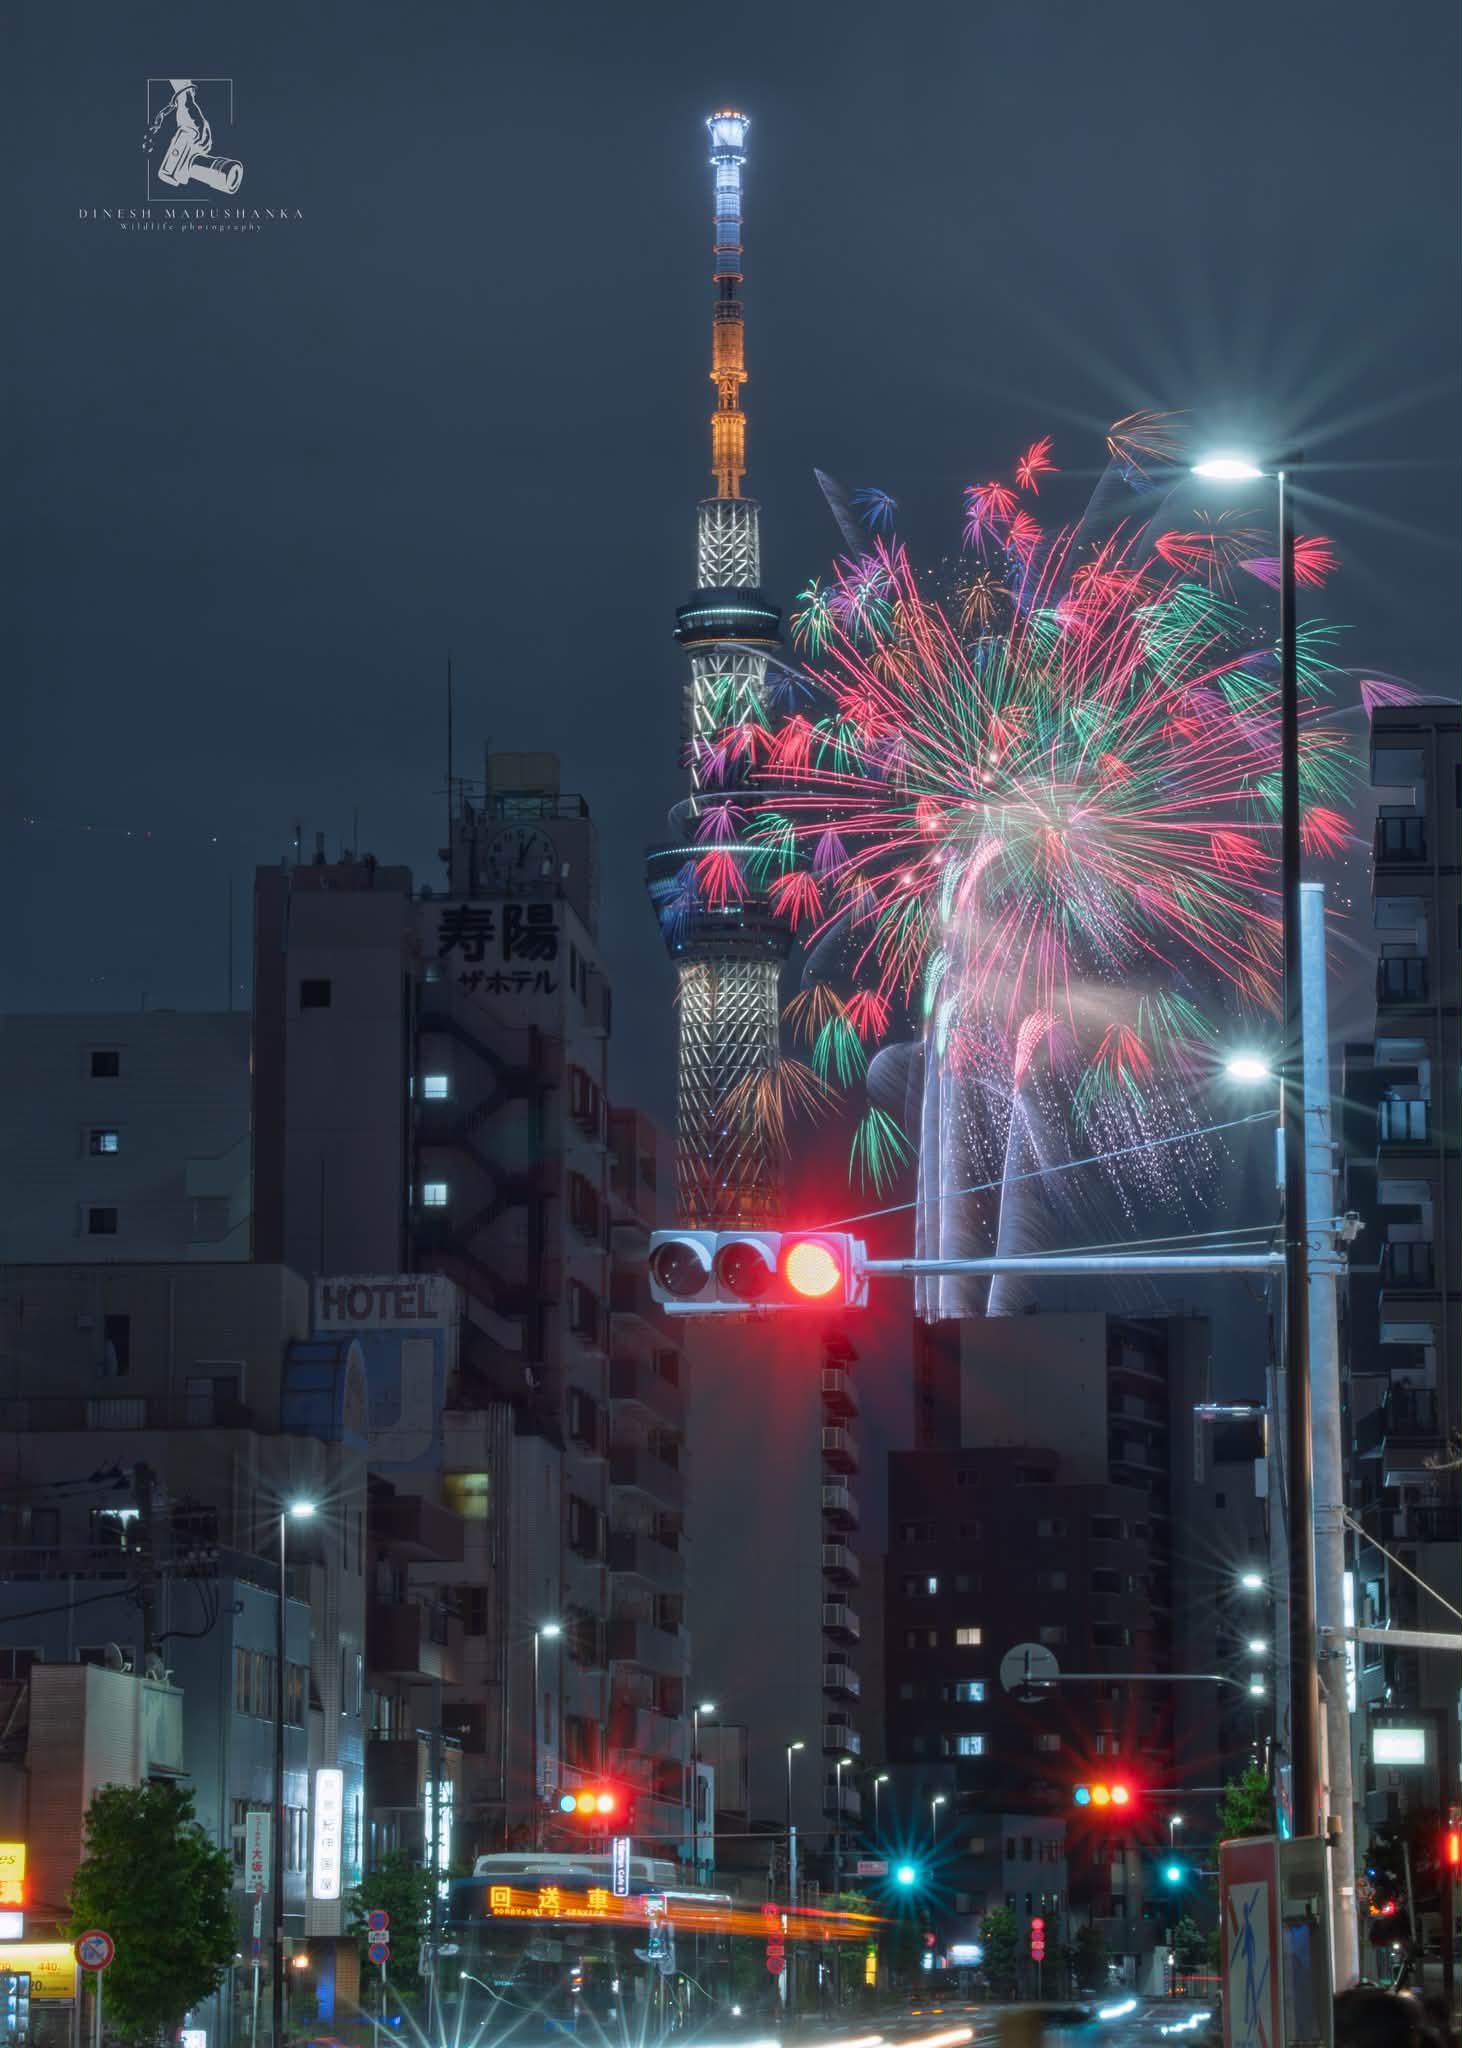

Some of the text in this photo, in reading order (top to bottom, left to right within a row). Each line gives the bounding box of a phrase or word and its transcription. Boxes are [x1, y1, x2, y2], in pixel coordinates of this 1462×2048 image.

[437, 904, 560, 963] 寿陽
[458, 968, 558, 995] ザホテル
[320, 1283, 439, 1321] HOTEL
[490, 1886, 609, 1909] 回送車
